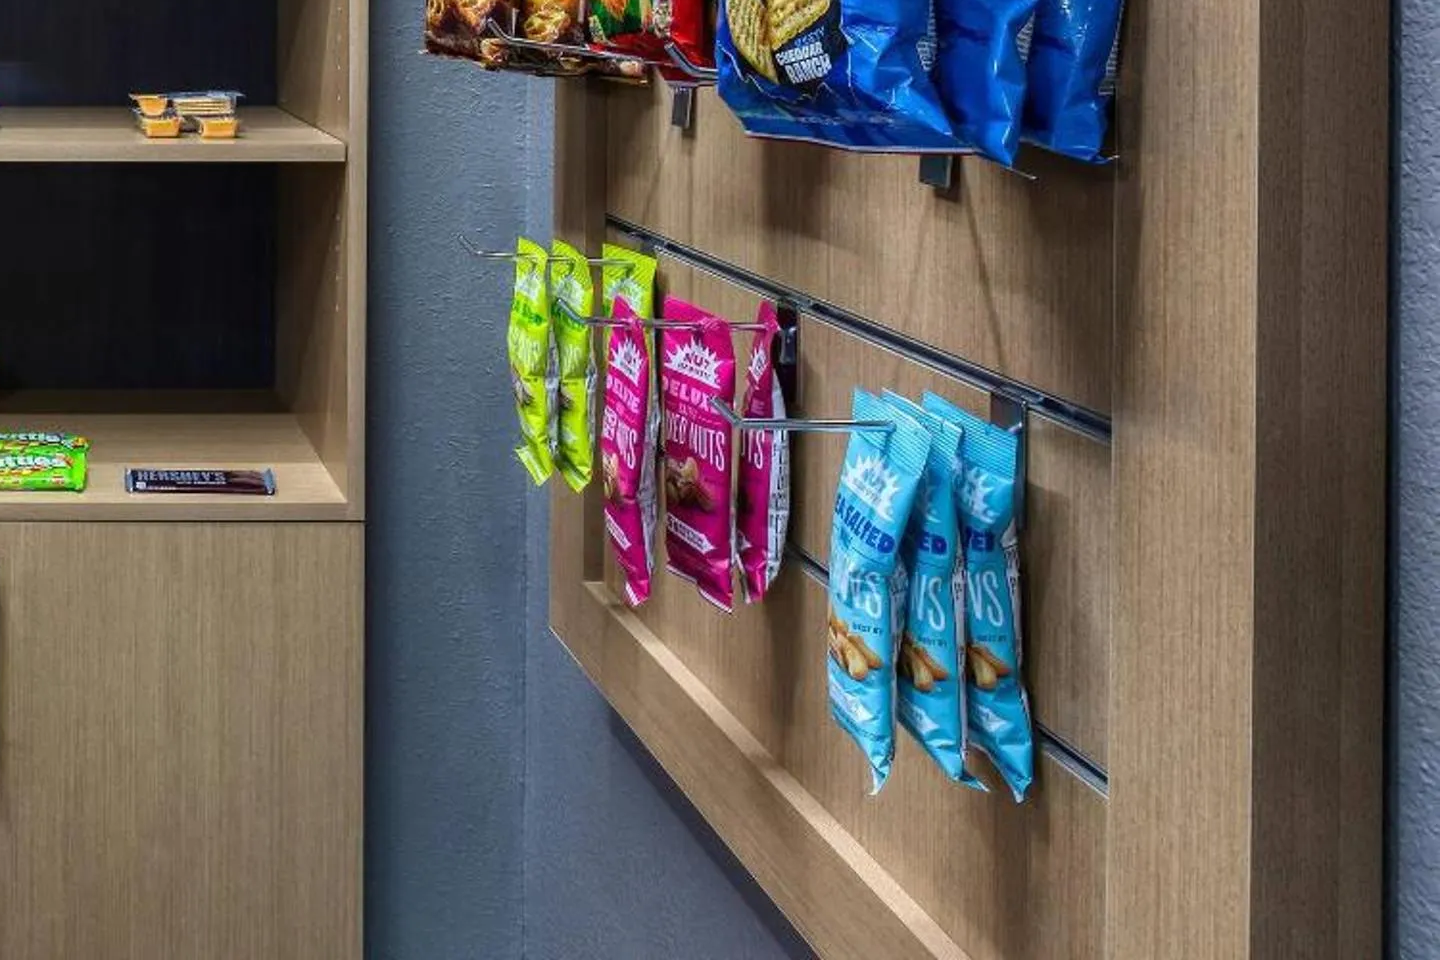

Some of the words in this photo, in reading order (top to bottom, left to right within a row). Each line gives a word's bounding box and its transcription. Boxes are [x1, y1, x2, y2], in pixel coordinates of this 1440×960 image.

[775, 41, 824, 66] CHEDDAR
[785, 53, 833, 84] RANCH
[137, 470, 227, 482] HERSHEY'S
